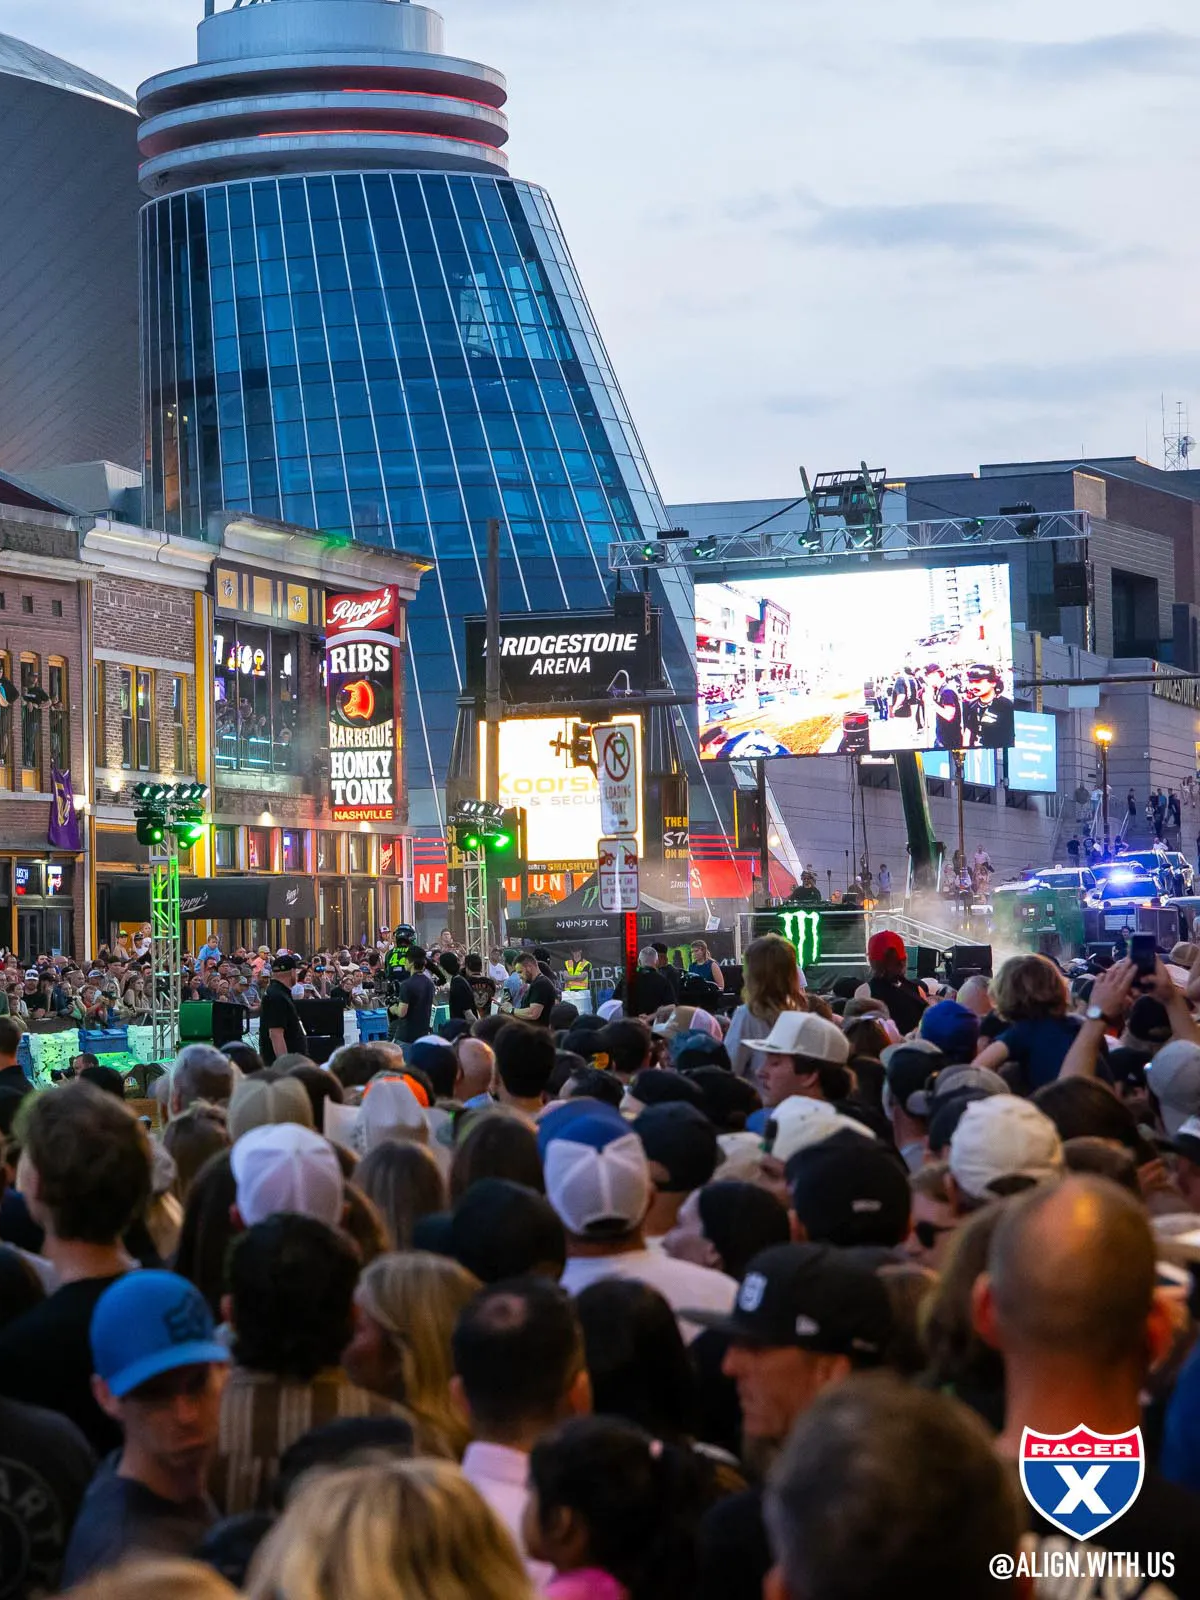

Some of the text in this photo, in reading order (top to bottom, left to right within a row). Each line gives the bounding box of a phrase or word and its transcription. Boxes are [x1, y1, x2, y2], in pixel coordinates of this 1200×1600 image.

[327, 588, 391, 624] Rippy's
[330, 644, 390, 673] RIBS
[530, 657, 591, 675] ARENA
[329, 719, 393, 748] BARBEQUE
[331, 751, 392, 778] HONKY
[331, 779, 393, 805] TONK
[605, 785, 631, 799] LOADING
[334, 810, 392, 820] NASHVILLE
[612, 801, 626, 815] ZONE
